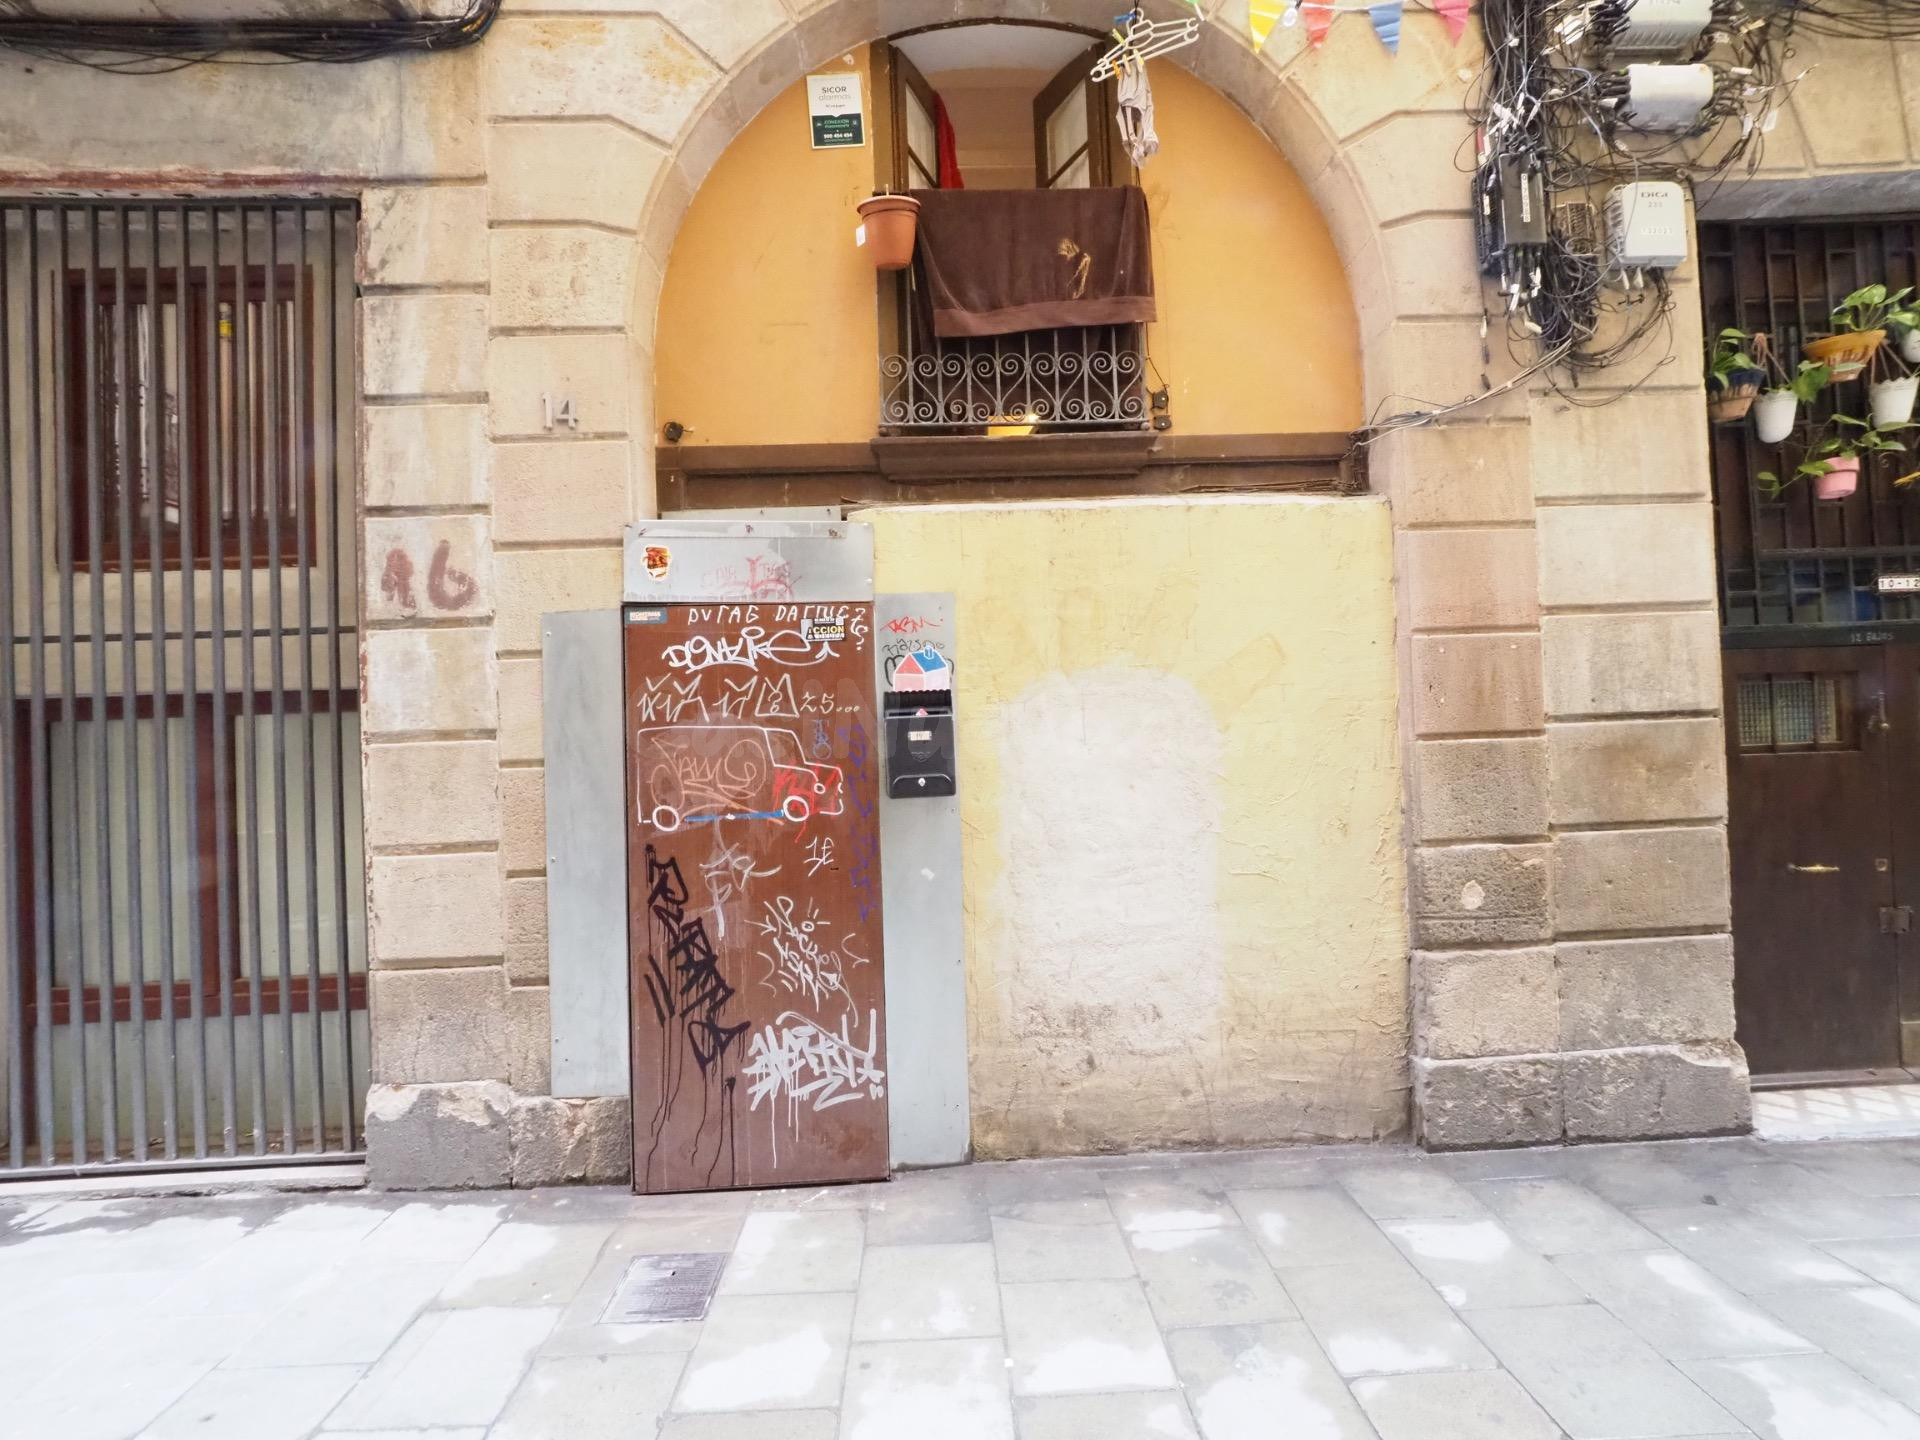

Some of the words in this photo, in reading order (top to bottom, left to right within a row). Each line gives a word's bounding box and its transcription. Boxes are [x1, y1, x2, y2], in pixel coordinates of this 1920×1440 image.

[822, 86, 847, 94] SICOR
[543, 391, 578, 431] 14
[380, 539, 478, 611] 16
